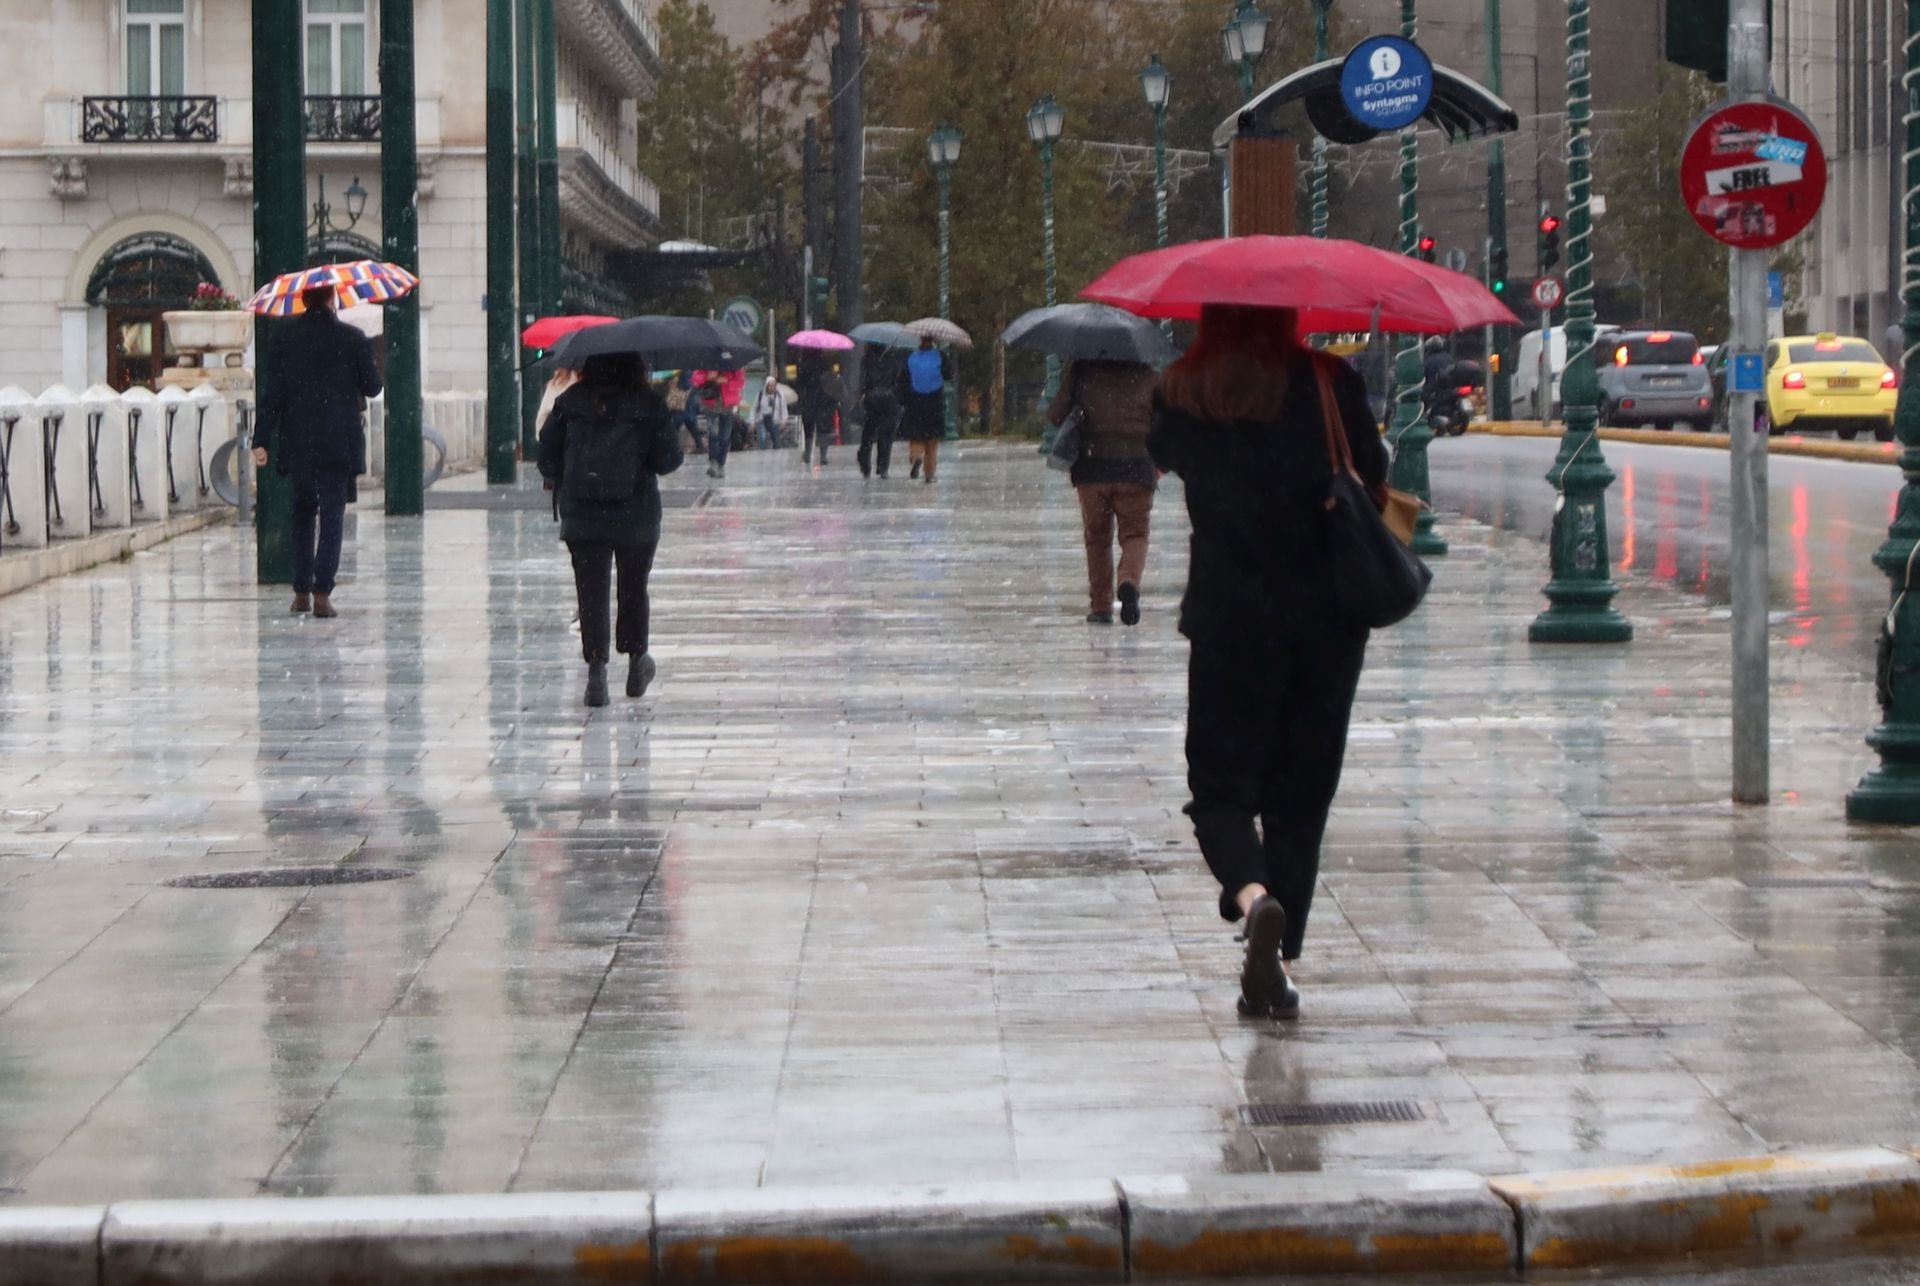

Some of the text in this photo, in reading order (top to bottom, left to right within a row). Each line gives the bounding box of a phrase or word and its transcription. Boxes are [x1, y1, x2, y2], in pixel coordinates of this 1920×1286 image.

[1355, 75, 1423, 97] INFO POINT
[1363, 93, 1418, 111] Syntagma
[1732, 167, 1771, 189] FREE
